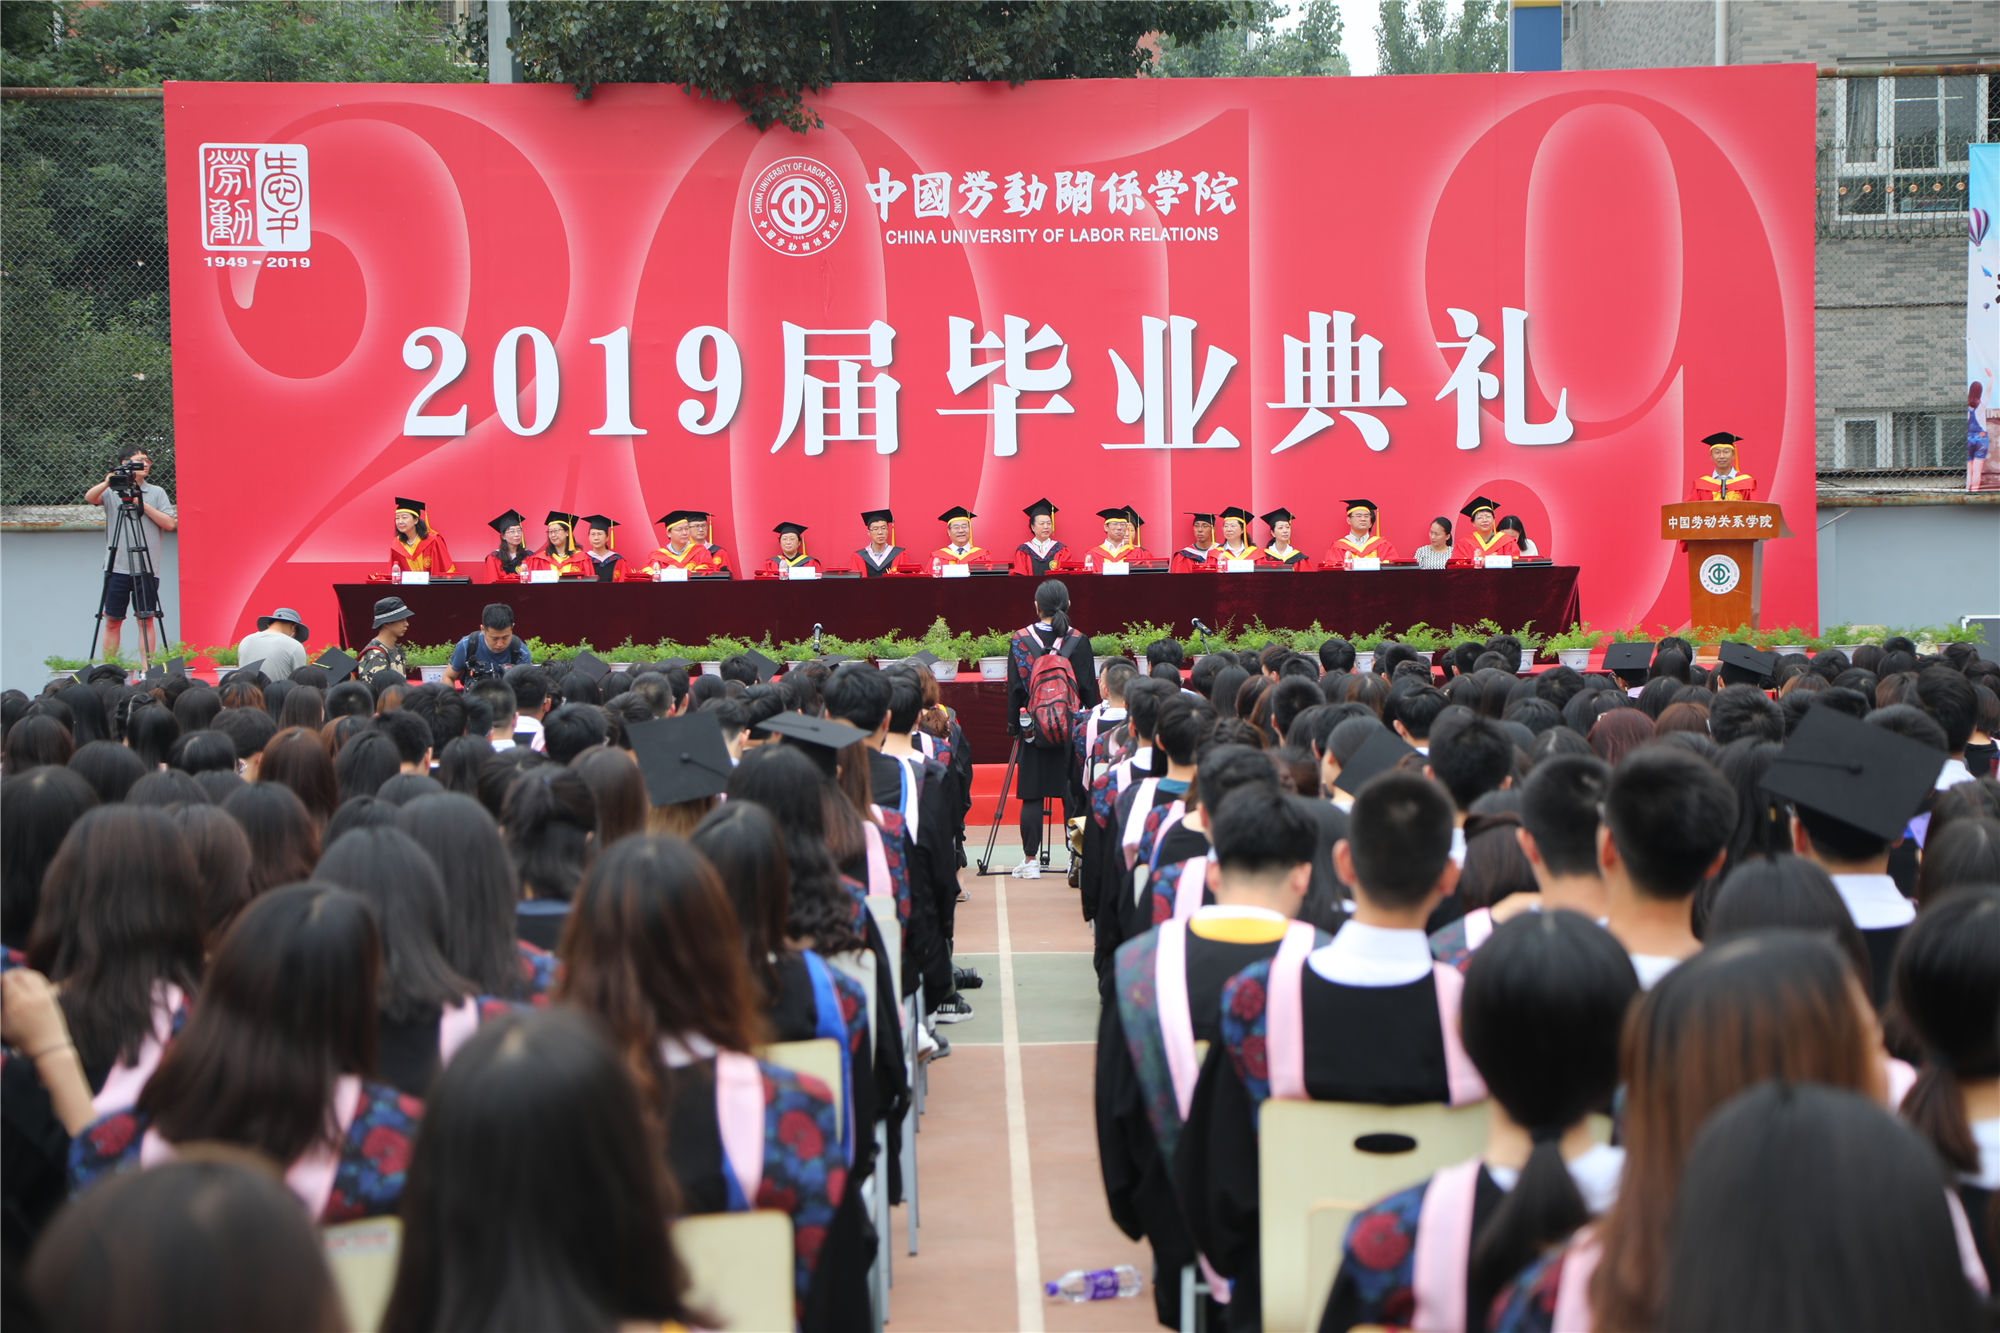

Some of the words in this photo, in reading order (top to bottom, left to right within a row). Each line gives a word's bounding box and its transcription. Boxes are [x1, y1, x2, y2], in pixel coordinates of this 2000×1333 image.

[758, 163, 792, 192] UNIVERSITY
[792, 162, 803, 171] OF
[803, 162, 827, 179] LABOR
[754, 192, 765, 214] CHINA
[824, 176, 842, 214] RELATIONS
[866, 168, 1239, 222] 中國勞動關係學院
[885, 229, 937, 245] CHINA
[941, 228, 1038, 244] UNIVERSITY
[1042, 227, 1065, 243] OF
[1070, 227, 1125, 243] LABOR
[1129, 226, 1219, 242] RELATIONS
[402, 306, 1574, 457] 2019届毕业典礼
[1668, 514, 1773, 530] 中国劳动关系学院
